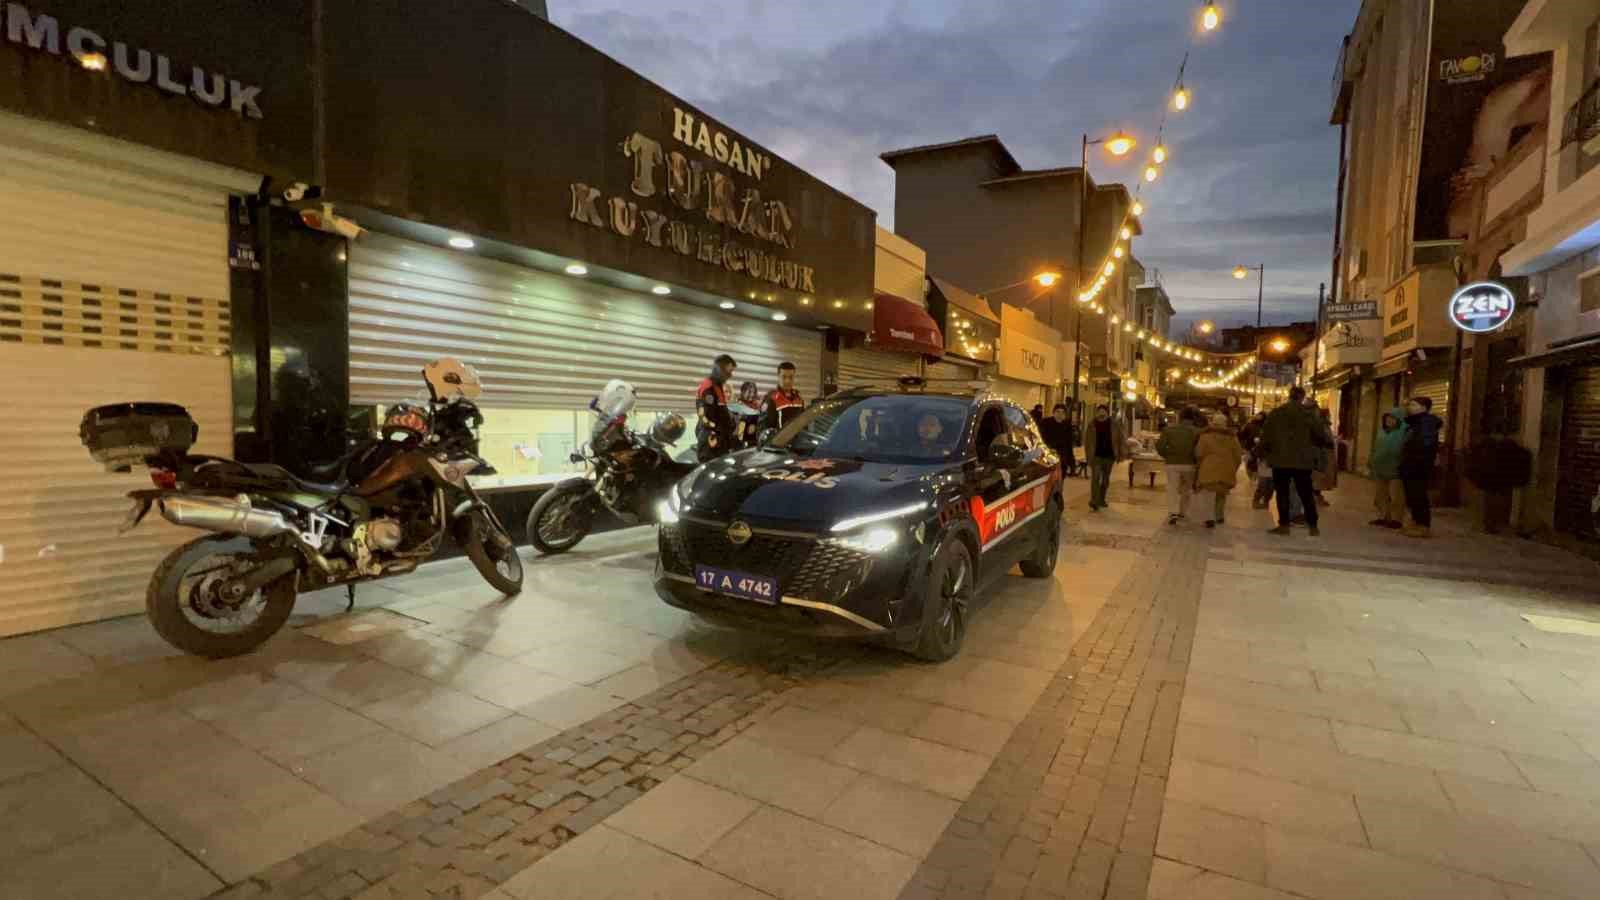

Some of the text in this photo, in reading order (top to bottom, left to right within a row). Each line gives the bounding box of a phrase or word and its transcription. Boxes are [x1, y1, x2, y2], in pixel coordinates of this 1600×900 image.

[0, 3, 264, 119] MCULUK
[1456, 293, 1509, 315] ZEN
[700, 570, 772, 597] 17 A 4742
